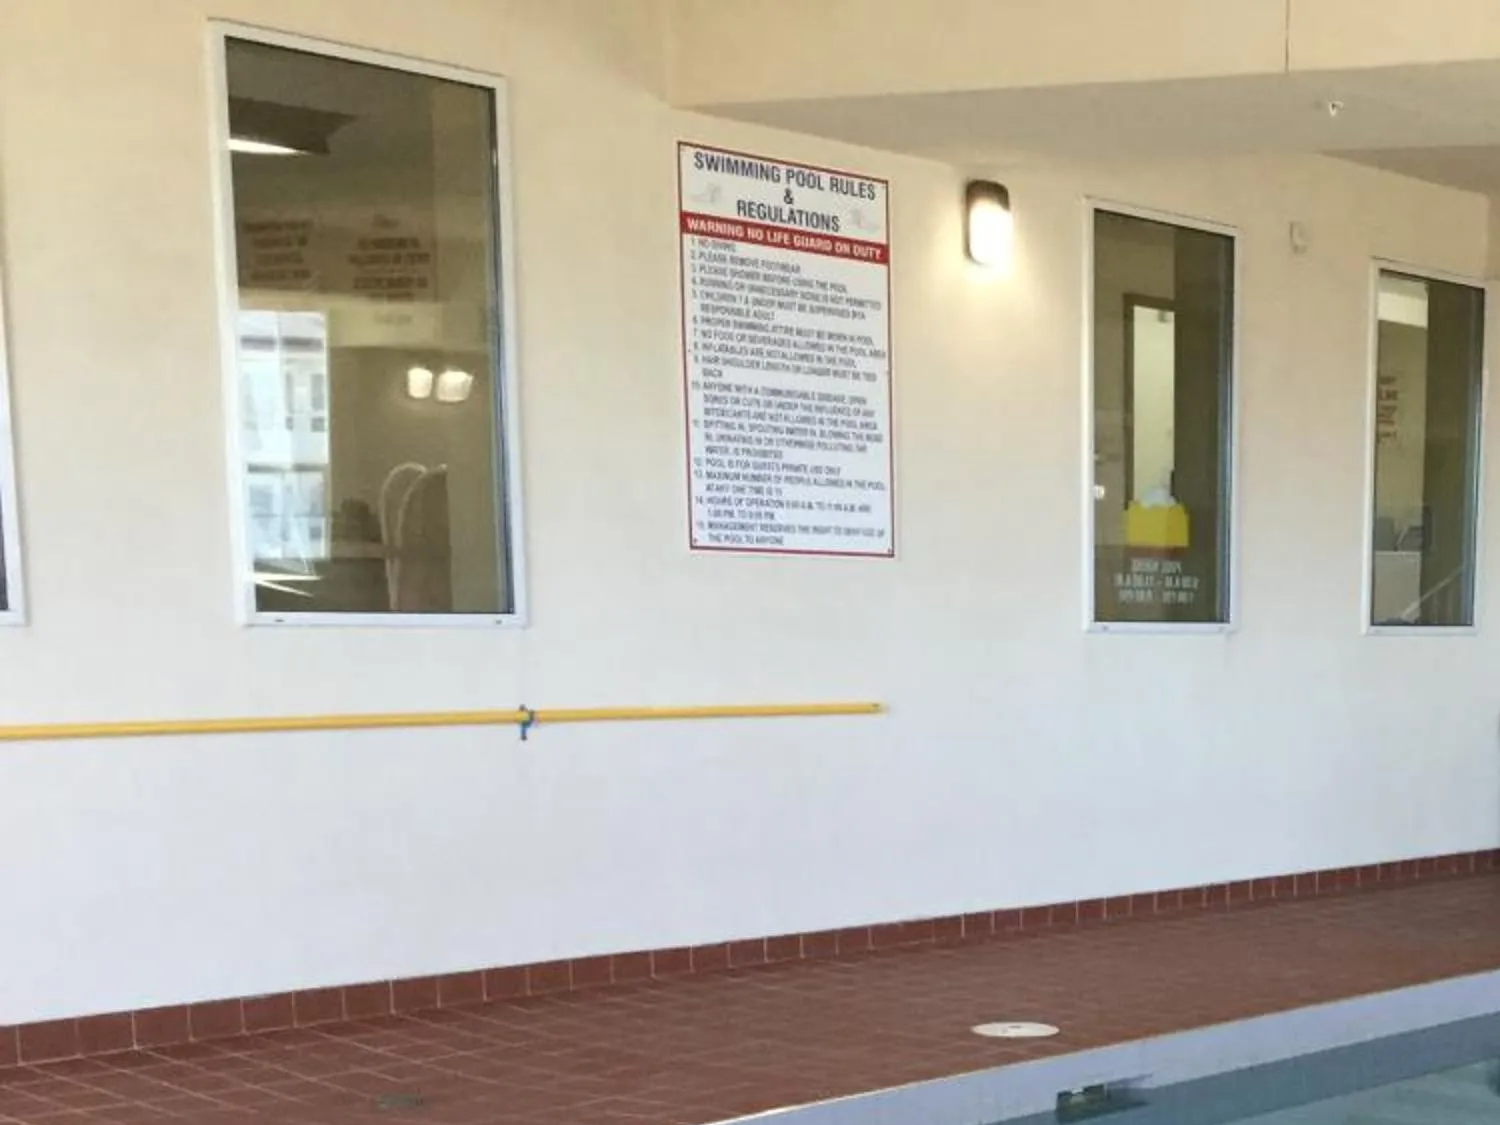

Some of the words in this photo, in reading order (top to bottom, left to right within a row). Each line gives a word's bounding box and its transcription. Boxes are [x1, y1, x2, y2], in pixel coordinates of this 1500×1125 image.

[694, 151, 781, 184] SWIMMING
[785, 167, 824, 192] POOL
[830, 175, 876, 201] RULES
[784, 187, 793, 205] &
[737, 199, 840, 232] REGULATIONS
[687, 218, 745, 239] WARNING
[747, 227, 764, 242] NO
[767, 230, 790, 246] LIFE
[793, 234, 832, 252] GUARD
[835, 241, 850, 255] ON
[853, 243, 881, 260] DUTY
